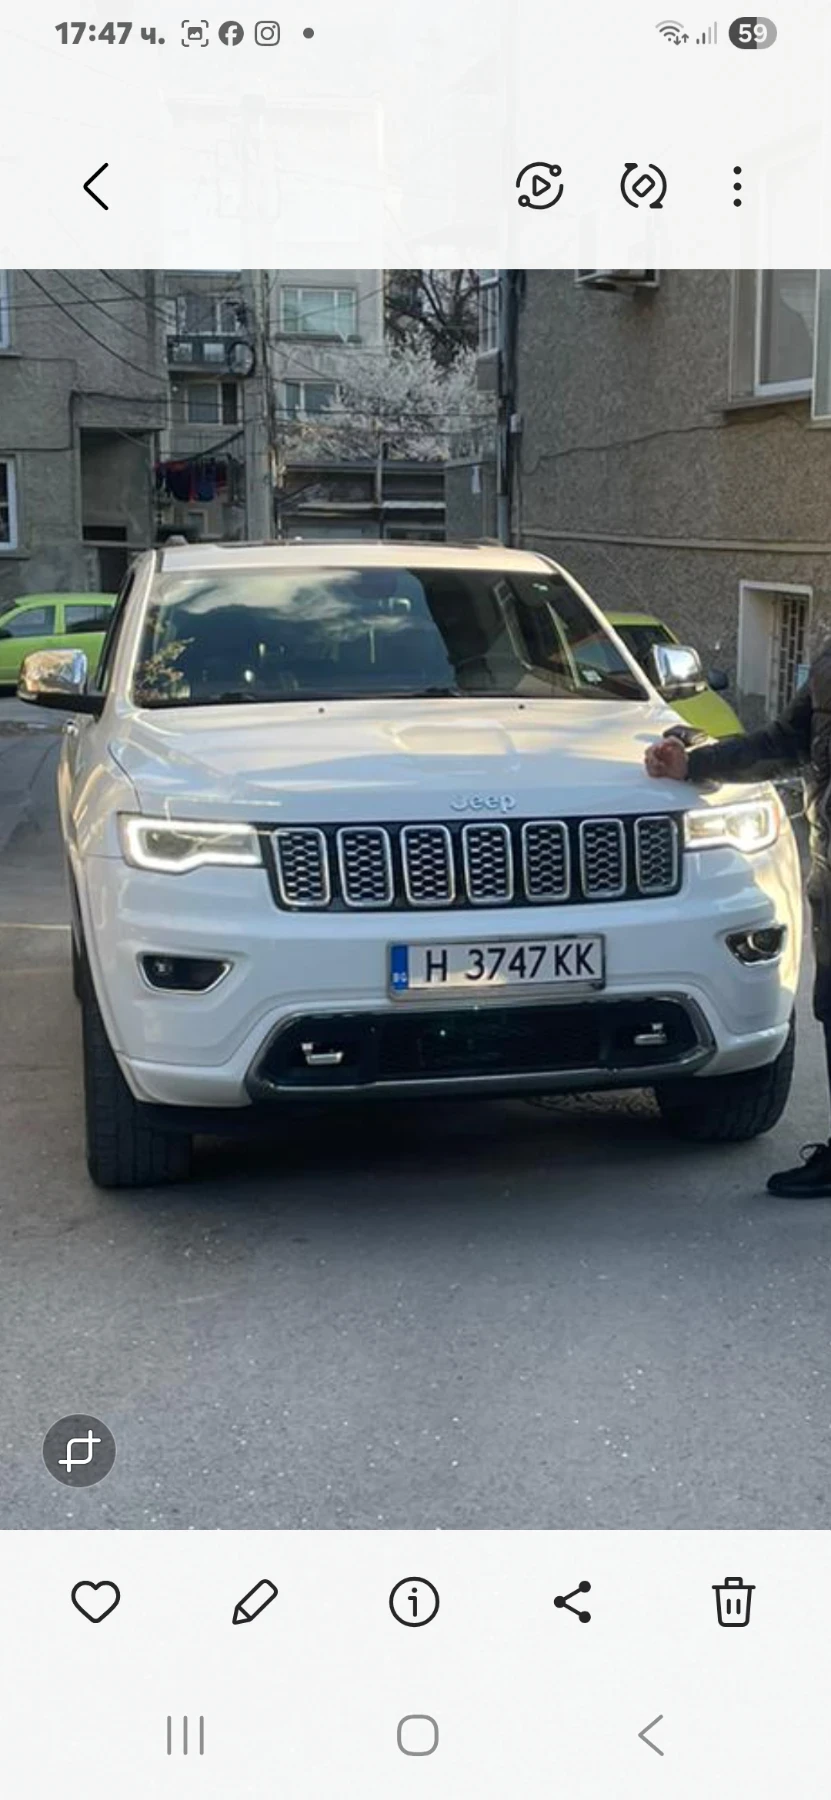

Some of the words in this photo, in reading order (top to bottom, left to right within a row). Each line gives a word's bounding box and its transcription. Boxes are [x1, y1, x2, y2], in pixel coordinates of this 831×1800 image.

[450, 793, 516, 814] Jeep
[426, 949, 448, 982] H
[464, 945, 547, 980] 3747
[554, 942, 595, 976] KK
